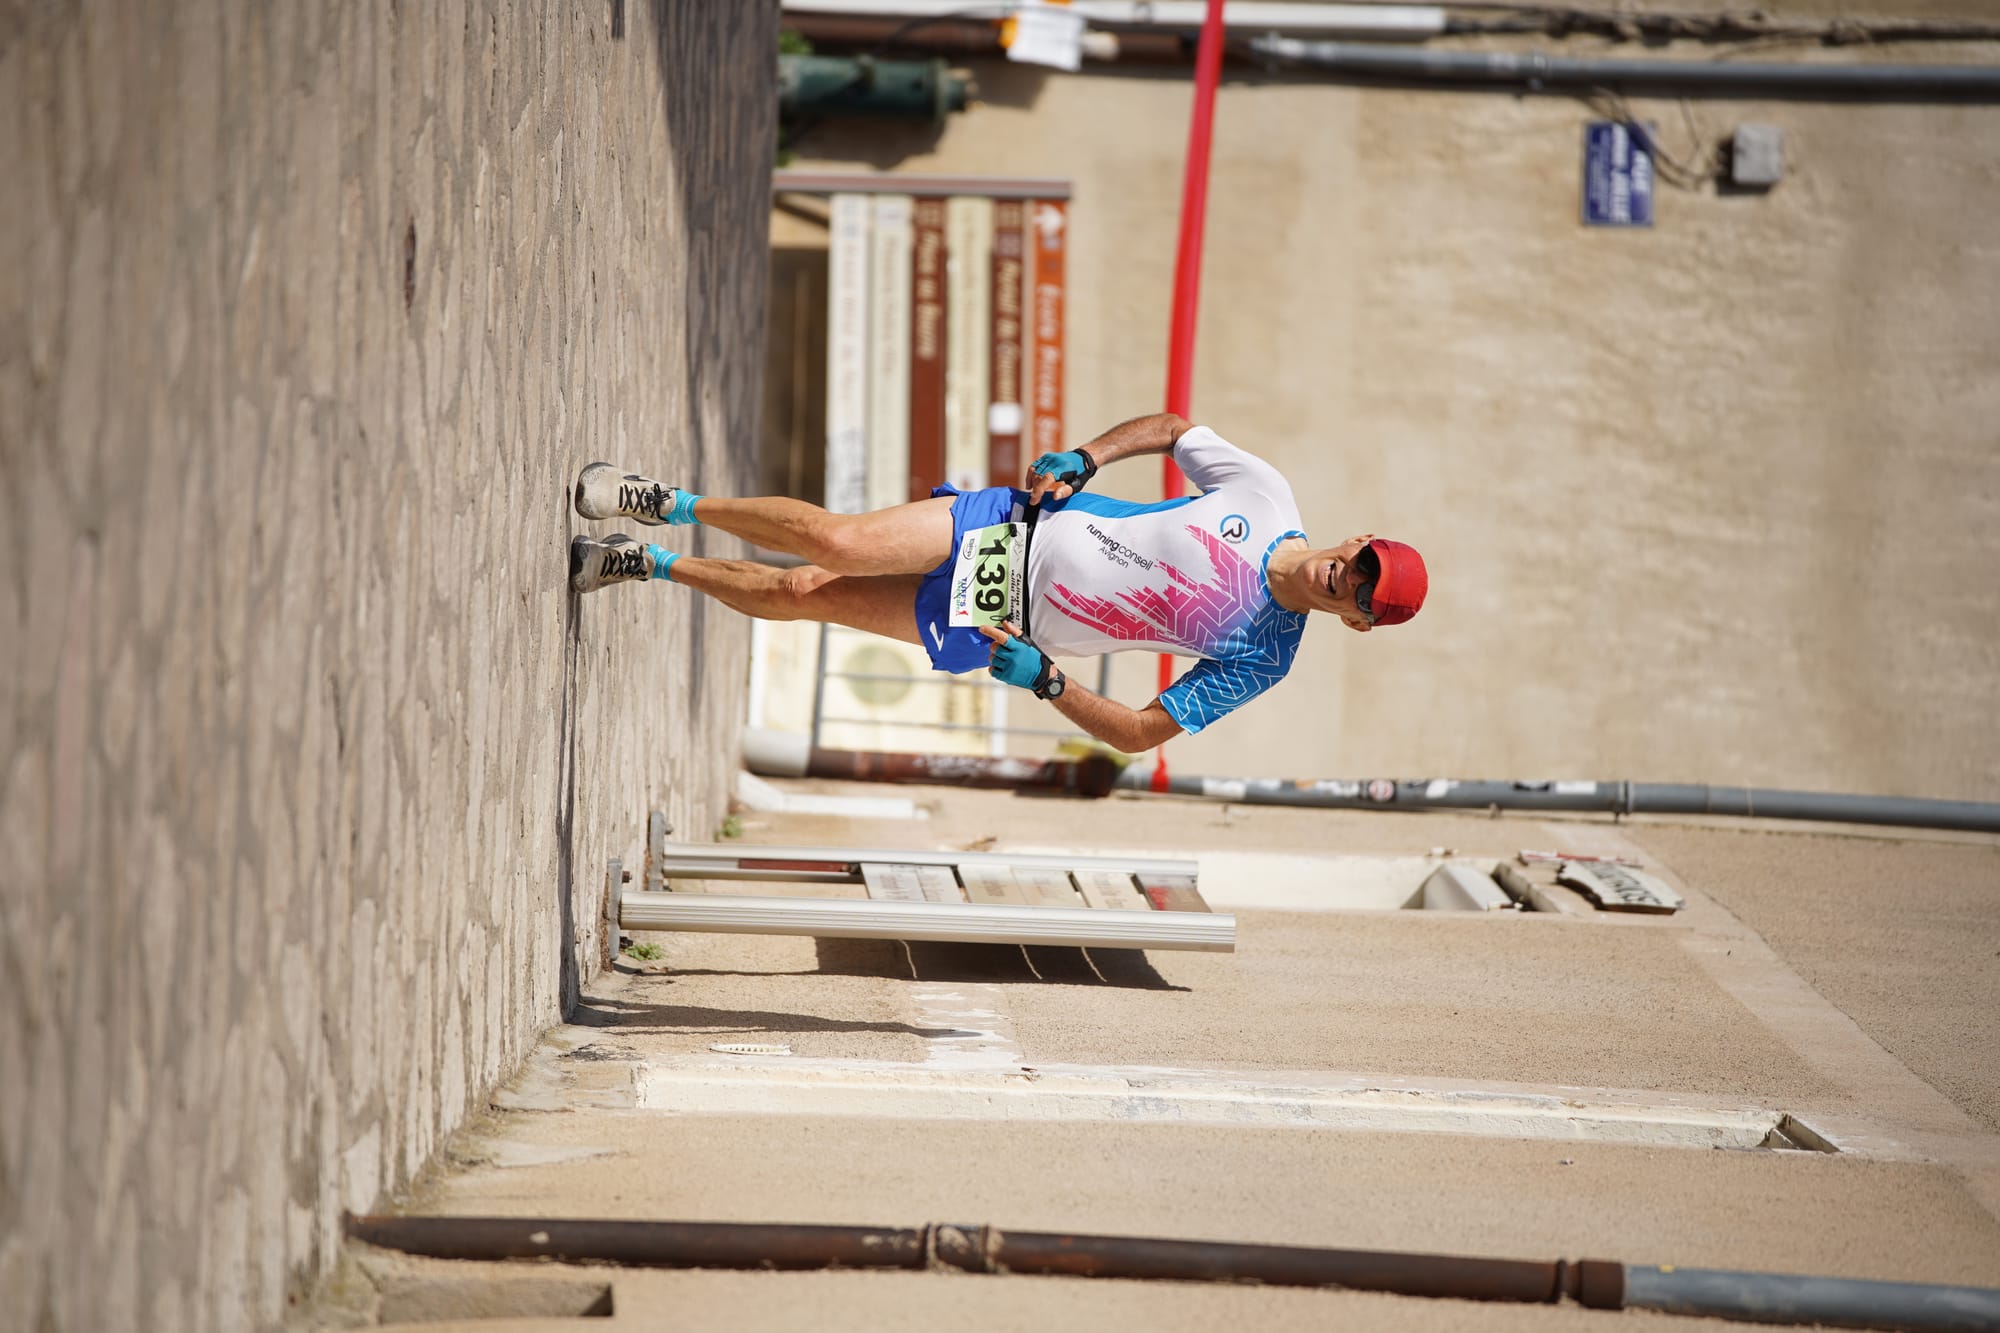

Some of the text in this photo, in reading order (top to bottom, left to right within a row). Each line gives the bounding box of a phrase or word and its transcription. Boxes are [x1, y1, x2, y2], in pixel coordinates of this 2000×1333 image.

[1086, 524, 1154, 571] runningconseil
[1097, 546, 1129, 569] Avignon
[960, 577, 968, 607] TUFF'S
[975, 539, 1007, 612] 139
